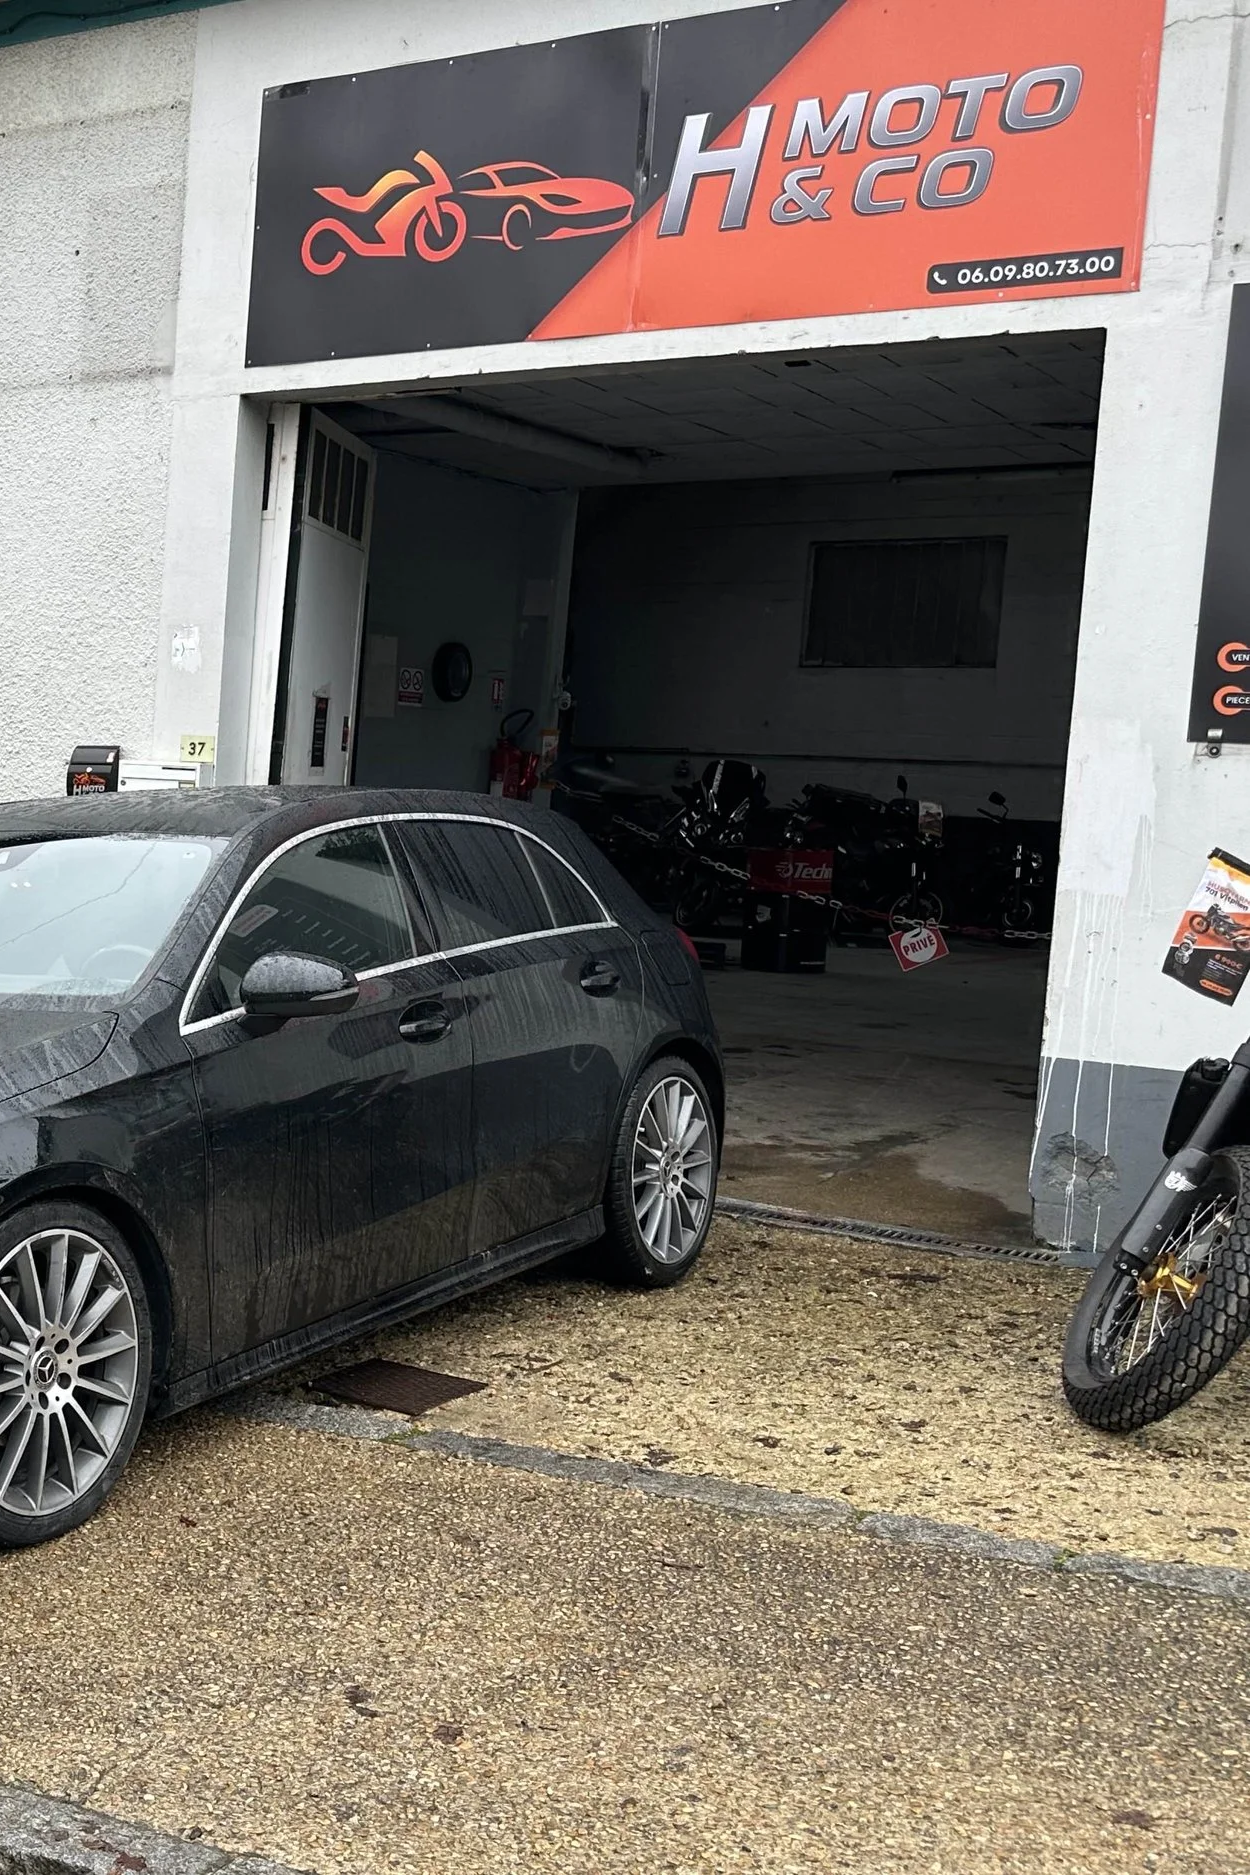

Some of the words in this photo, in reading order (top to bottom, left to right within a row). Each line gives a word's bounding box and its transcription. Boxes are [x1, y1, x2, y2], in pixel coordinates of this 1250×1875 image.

[657, 104, 774, 239] H
[783, 64, 1083, 161] MOTO
[770, 165, 834, 226] &
[853, 148, 995, 216] CO
[957, 254, 1116, 286] 06.09.80.73.00
[188, 742, 206, 756] 37
[73, 784, 82, 796] H
[1205, 886, 1218, 898] 701
[903, 932, 935, 956] PRIVÉ
